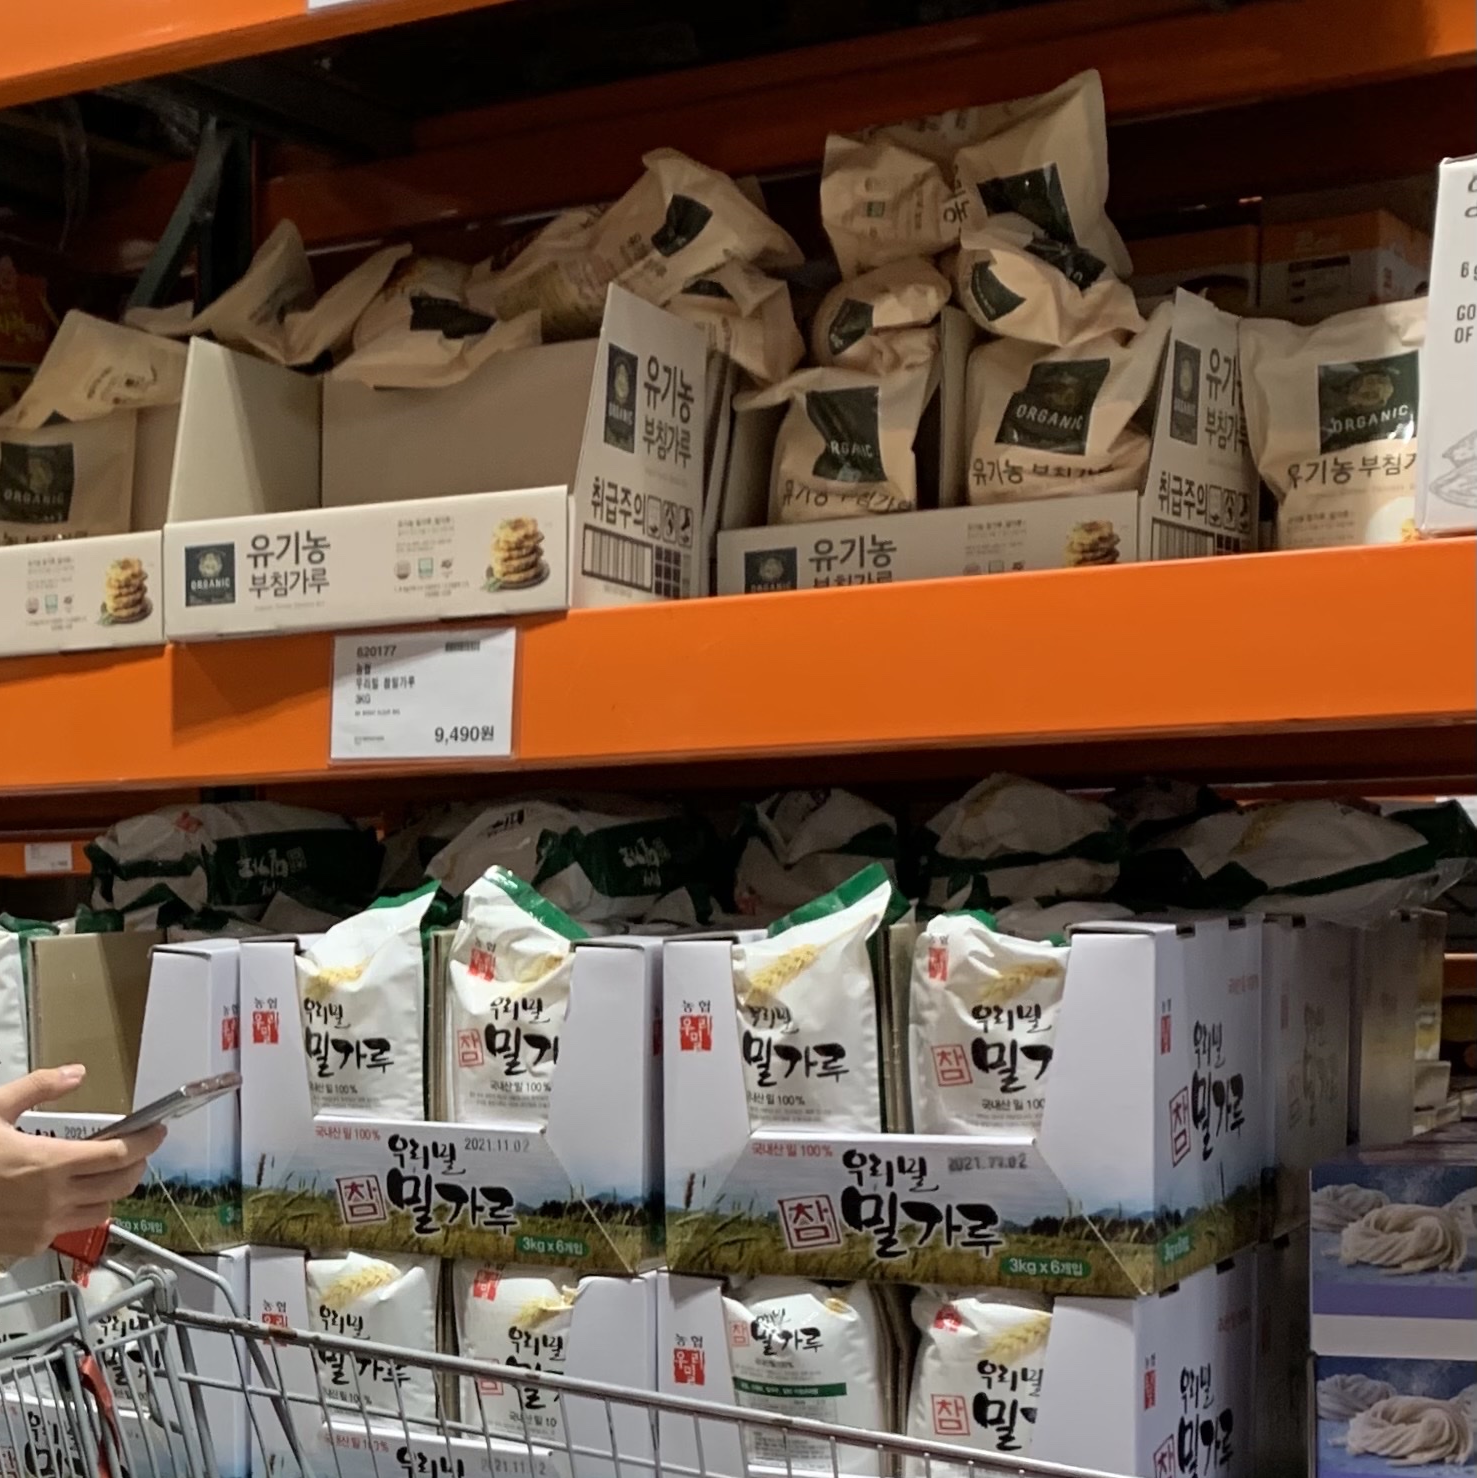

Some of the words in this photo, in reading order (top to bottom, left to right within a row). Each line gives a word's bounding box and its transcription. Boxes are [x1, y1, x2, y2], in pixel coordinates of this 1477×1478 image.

[643, 355, 694, 425] 유기농
[1015, 404, 1084, 431] ORGANIC
[1331, 404, 1413, 434] ORGANIC
[642, 415, 691, 469] 부침가루
[972, 458, 1023, 487] 유기농
[591, 476, 646, 535] 취급주의
[1158, 471, 1208, 524] 취급주의
[246, 530, 331, 570] 유기농
[808, 534, 897, 573] 유기농
[190, 578, 231, 592] ORGANIC
[248, 568, 330, 600] 부침가루
[434, 725, 494, 745] 9,490원
[254, 997, 278, 1009] 농협
[303, 998, 351, 1029] 우리밀
[490, 997, 552, 1024] 우리밀
[682, 1000, 711, 1013] 농협
[680, 1015, 712, 1052] 우리밀
[972, 1004, 1052, 1034] 우리밀
[305, 1033, 395, 1078] 밀가루
[743, 1031, 850, 1088] 밀가루
[934, 1048, 969, 1083] 참
[490, 1081, 513, 1092] 국내산
[526, 1082, 552, 1093] 100%
[777, 1094, 805, 1106] 100%
[982, 1098, 1011, 1112] 국내산
[1192, 1069, 1245, 1162] 밀가루
[315, 1125, 341, 1138] 국내산
[342, 1126, 352, 1139] 밀
[354, 1127, 381, 1141] 100%
[387, 1133, 466, 1175] 우리밀
[464, 1137, 530, 1153] 2021.11.02
[752, 1142, 784, 1157] 국내산
[785, 1143, 797, 1157] 밀
[800, 1144, 833, 1158] 100%
[842, 1149, 940, 1193] 우리밀
[338, 1177, 385, 1222] 참
[386, 1167, 518, 1240] 밀가루
[780, 1198, 839, 1247] 참
[840, 1187, 1003, 1260] 밀가루
[522, 1236, 544, 1252] 3kg
[556, 1240, 584, 1256] 6개입
[1008, 1257, 1037, 1275] 3kg
[1050, 1259, 1084, 1277] 6개입
[263, 1300, 287, 1313] 농협
[508, 1326, 566, 1361] 우리밀
[674, 1333, 704, 1348] 농협
[673, 1348, 705, 1385] 우리밀
[977, 1359, 1043, 1398] 우리밀
